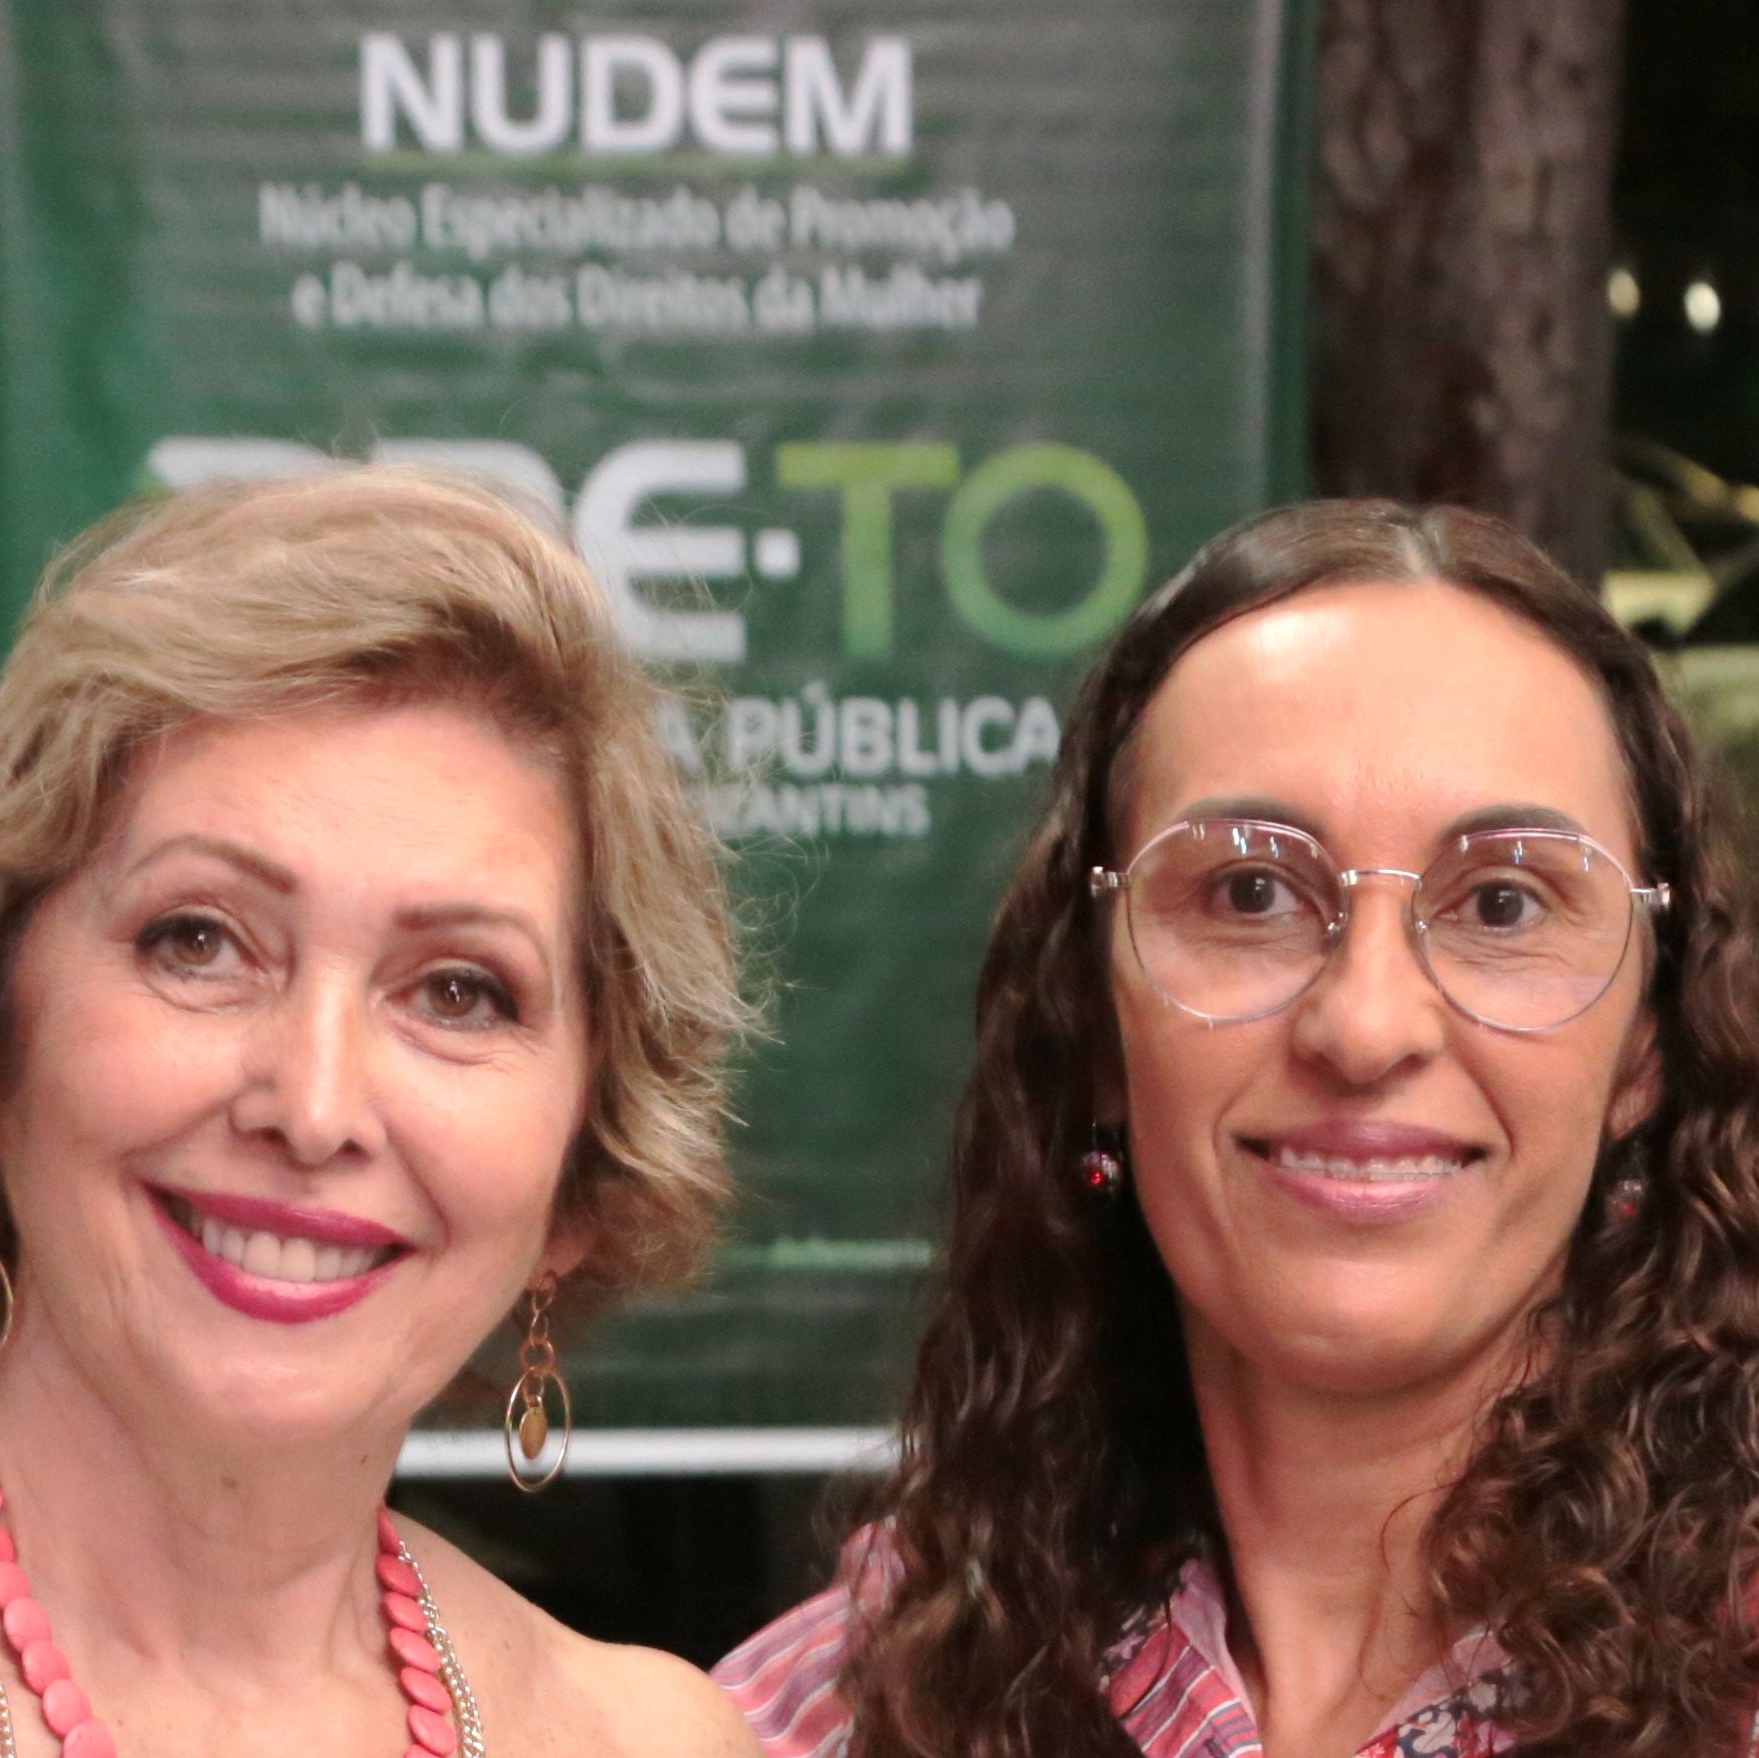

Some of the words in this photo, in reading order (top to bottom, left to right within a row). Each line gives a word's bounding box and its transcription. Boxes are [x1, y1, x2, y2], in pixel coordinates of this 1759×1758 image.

[359, 30, 914, 156] NUDEM
[725, 183, 786, 249] de
[290, 274, 327, 329] e
[331, 260, 484, 328] Defesa
[489, 263, 573, 328] dos
[754, 263, 815, 331] da
[819, 264, 983, 331] Mulher
[725, 678, 1061, 778] PÚBLICA
